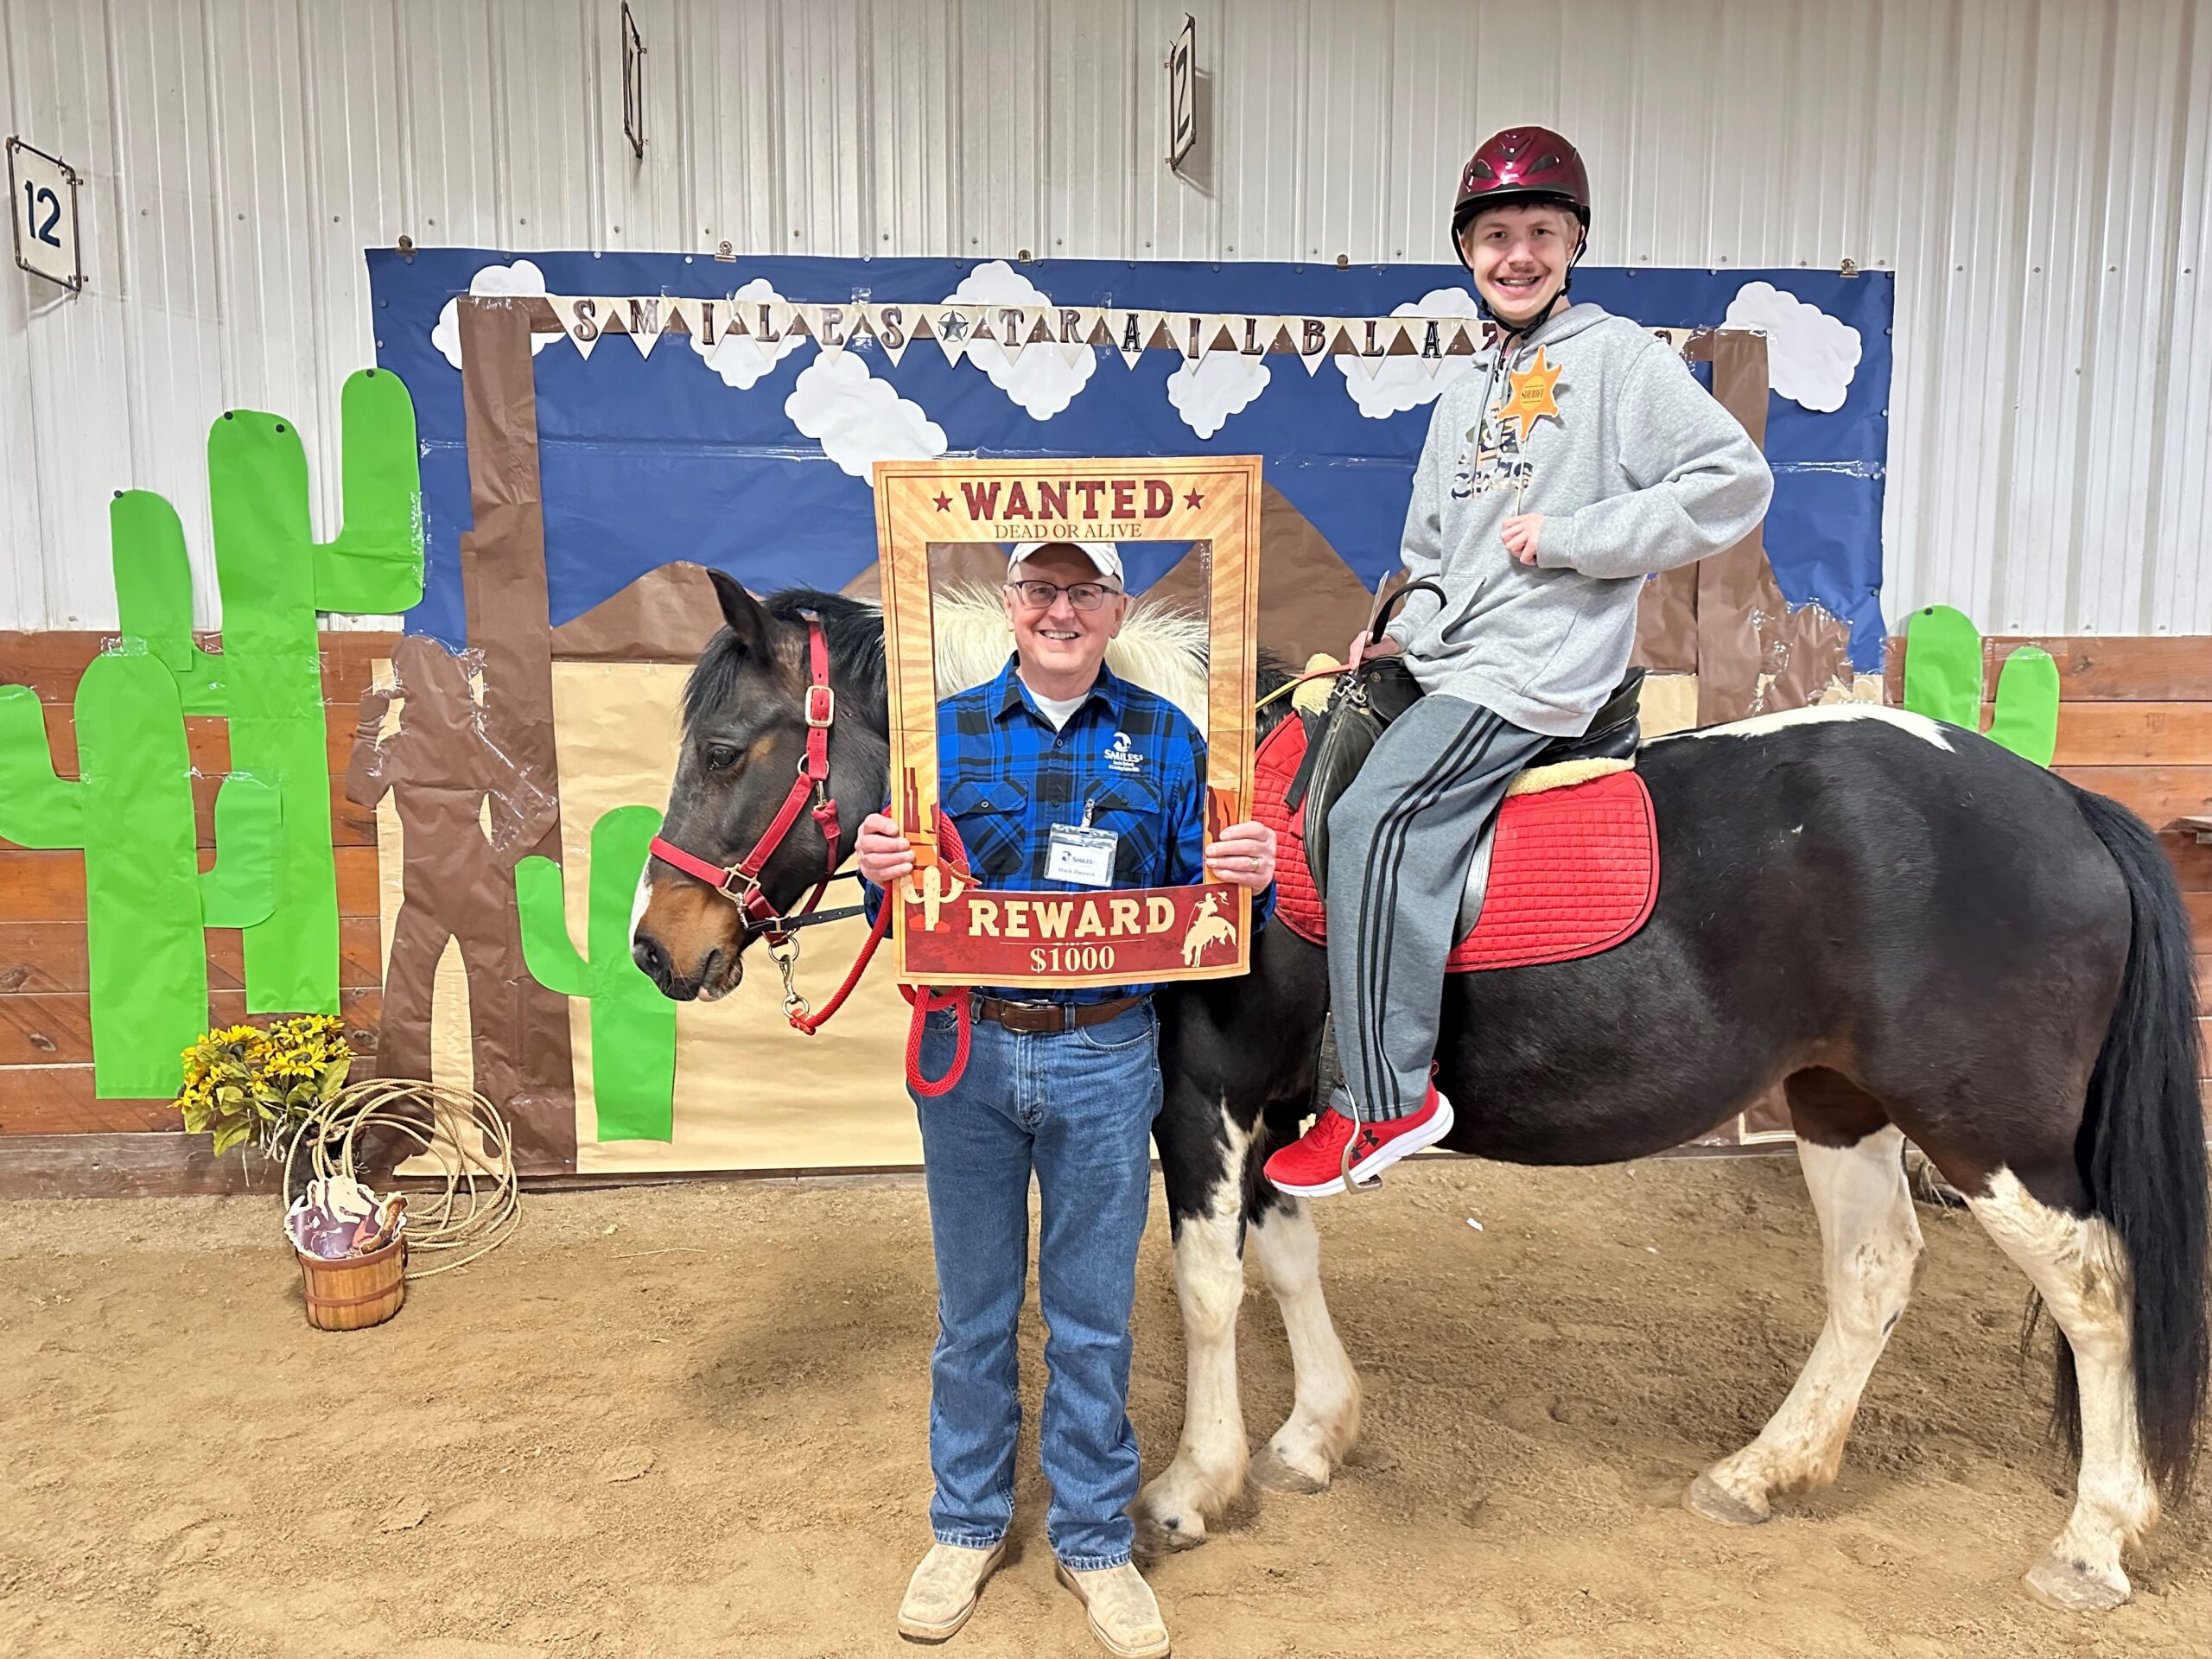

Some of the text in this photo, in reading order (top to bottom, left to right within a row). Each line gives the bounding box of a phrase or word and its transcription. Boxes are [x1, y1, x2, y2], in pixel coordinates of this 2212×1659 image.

[24, 180, 60, 248] 12
[572, 299, 903, 349] SMILES
[1521, 388, 1544, 399] SHERIFF
[961, 480, 1174, 520] WANTED
[995, 523, 1142, 539] DEAD OR ALIVE
[1104, 748, 1140, 763] SMILES
[968, 896, 1176, 938] REWARD
[1030, 945, 1116, 974] $1000
